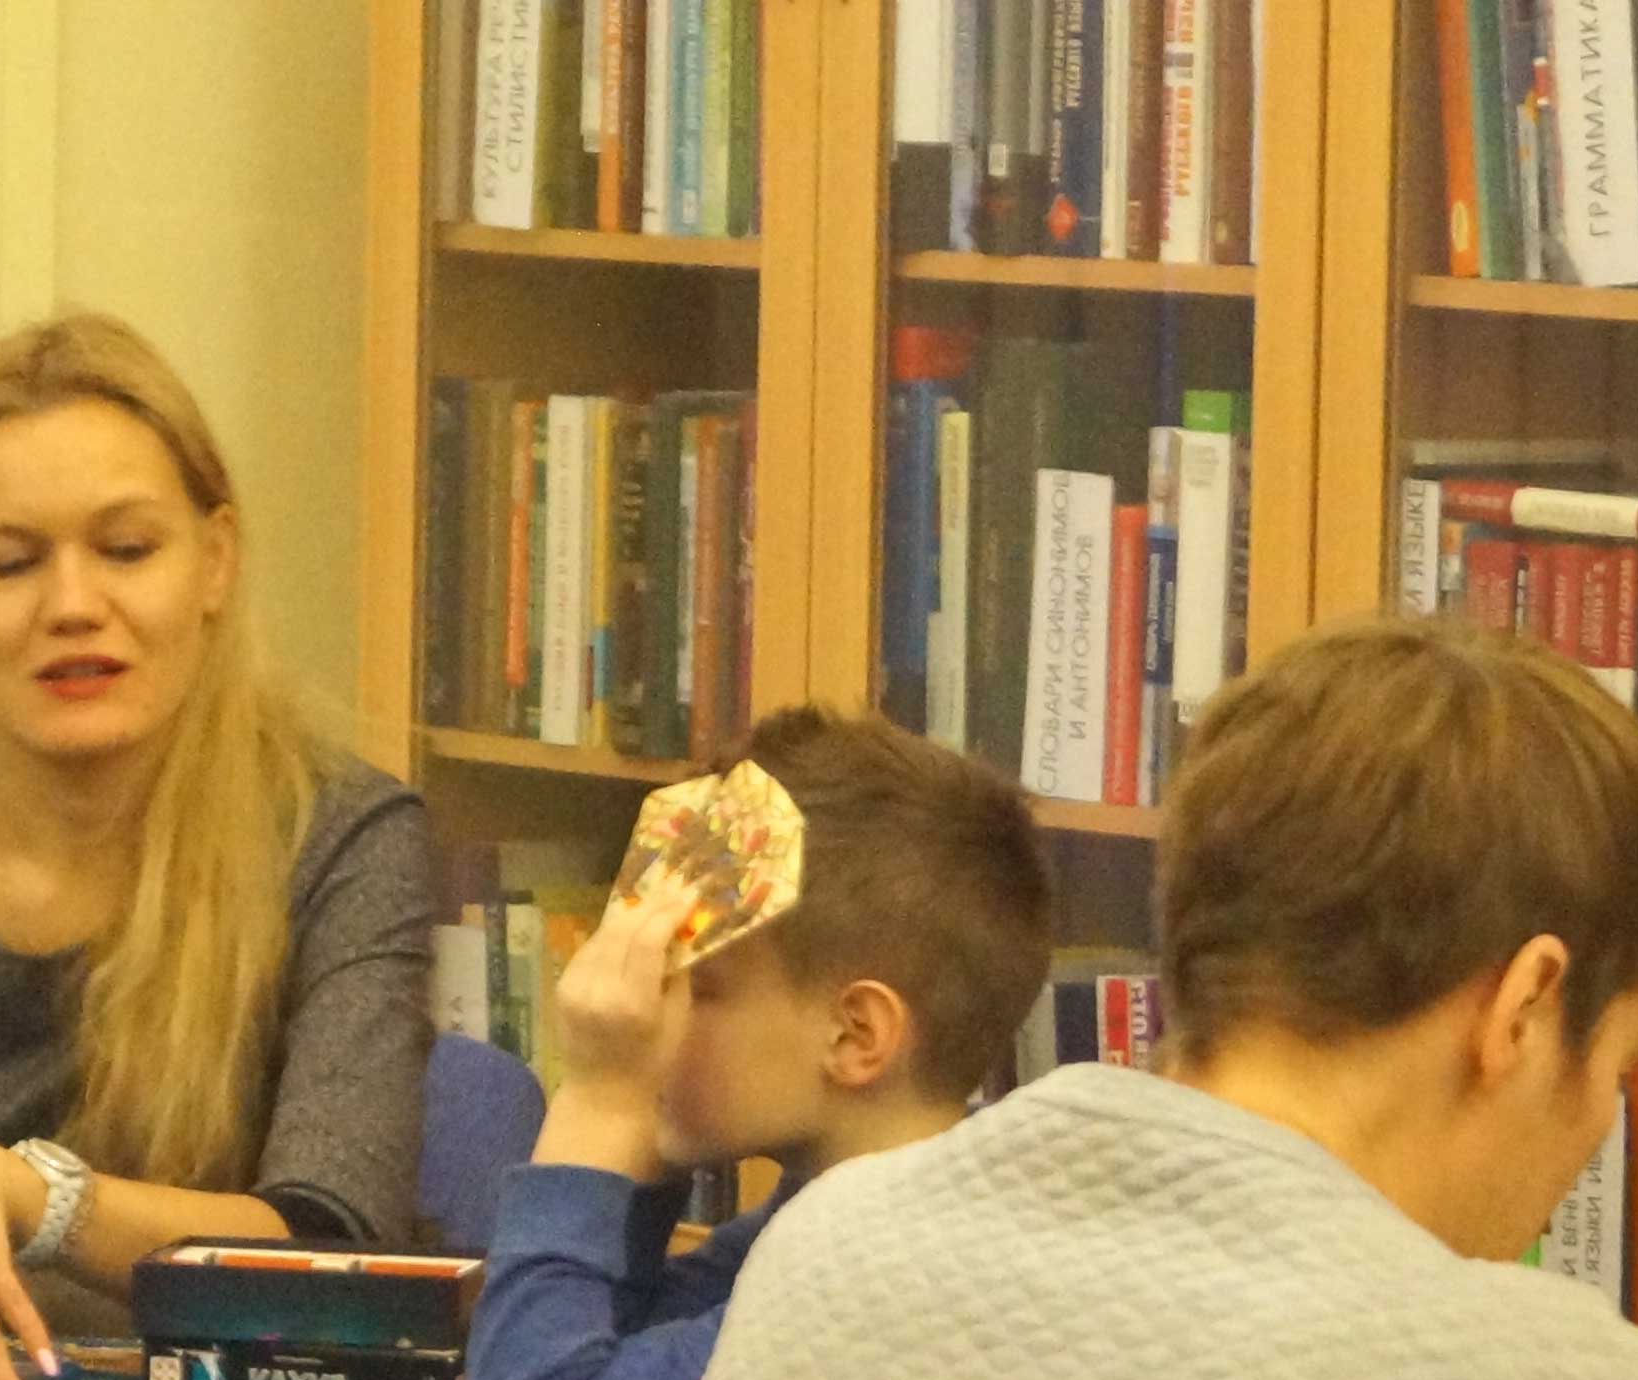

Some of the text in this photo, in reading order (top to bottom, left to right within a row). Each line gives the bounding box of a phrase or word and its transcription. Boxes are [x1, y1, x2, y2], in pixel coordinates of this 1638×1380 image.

[1578, 0, 1610, 237] ГРАММАТИКА
[1036, 471, 1072, 795] СЛОВАРИ СИНОНИМОВ
[1068, 533, 1094, 740] И АНТОНИМОВ
[1586, 1196, 1603, 1273] ЯЗЫКИ
